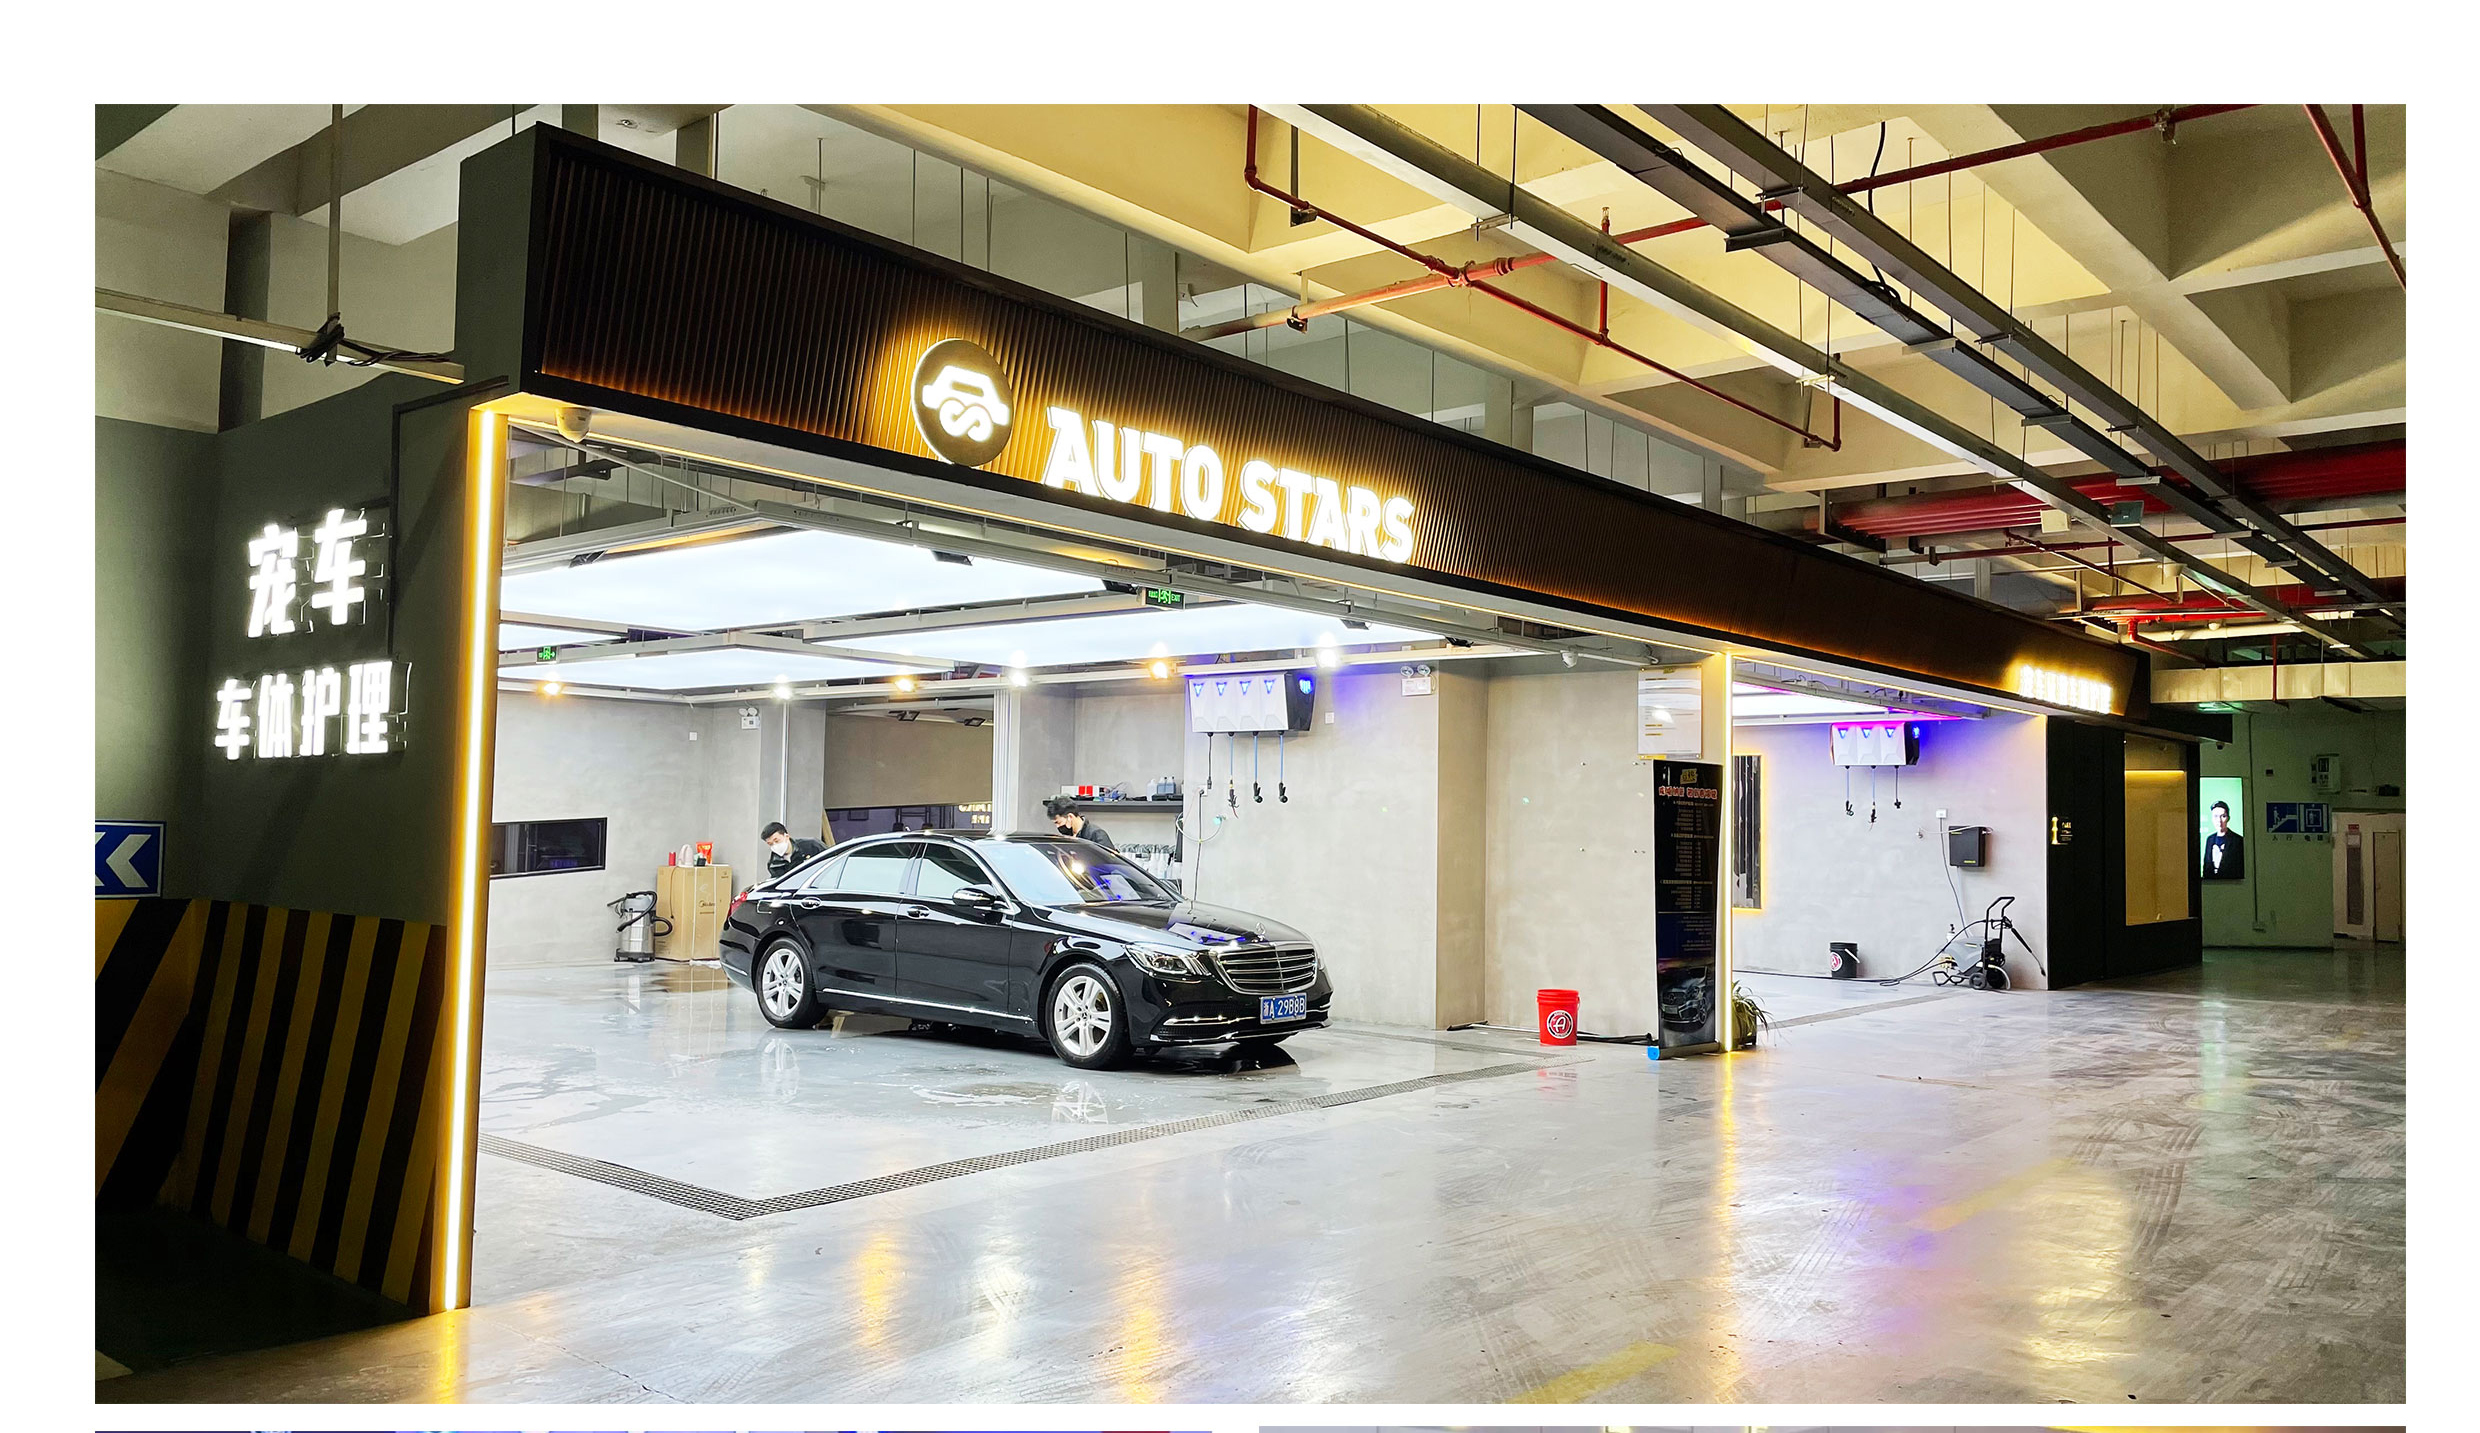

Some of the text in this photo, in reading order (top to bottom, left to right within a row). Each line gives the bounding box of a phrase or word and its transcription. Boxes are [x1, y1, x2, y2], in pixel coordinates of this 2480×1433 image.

[1041, 405, 1415, 564] AUTO STARS
[247, 508, 369, 638] 宠车
[214, 661, 394, 761] 车体护理
